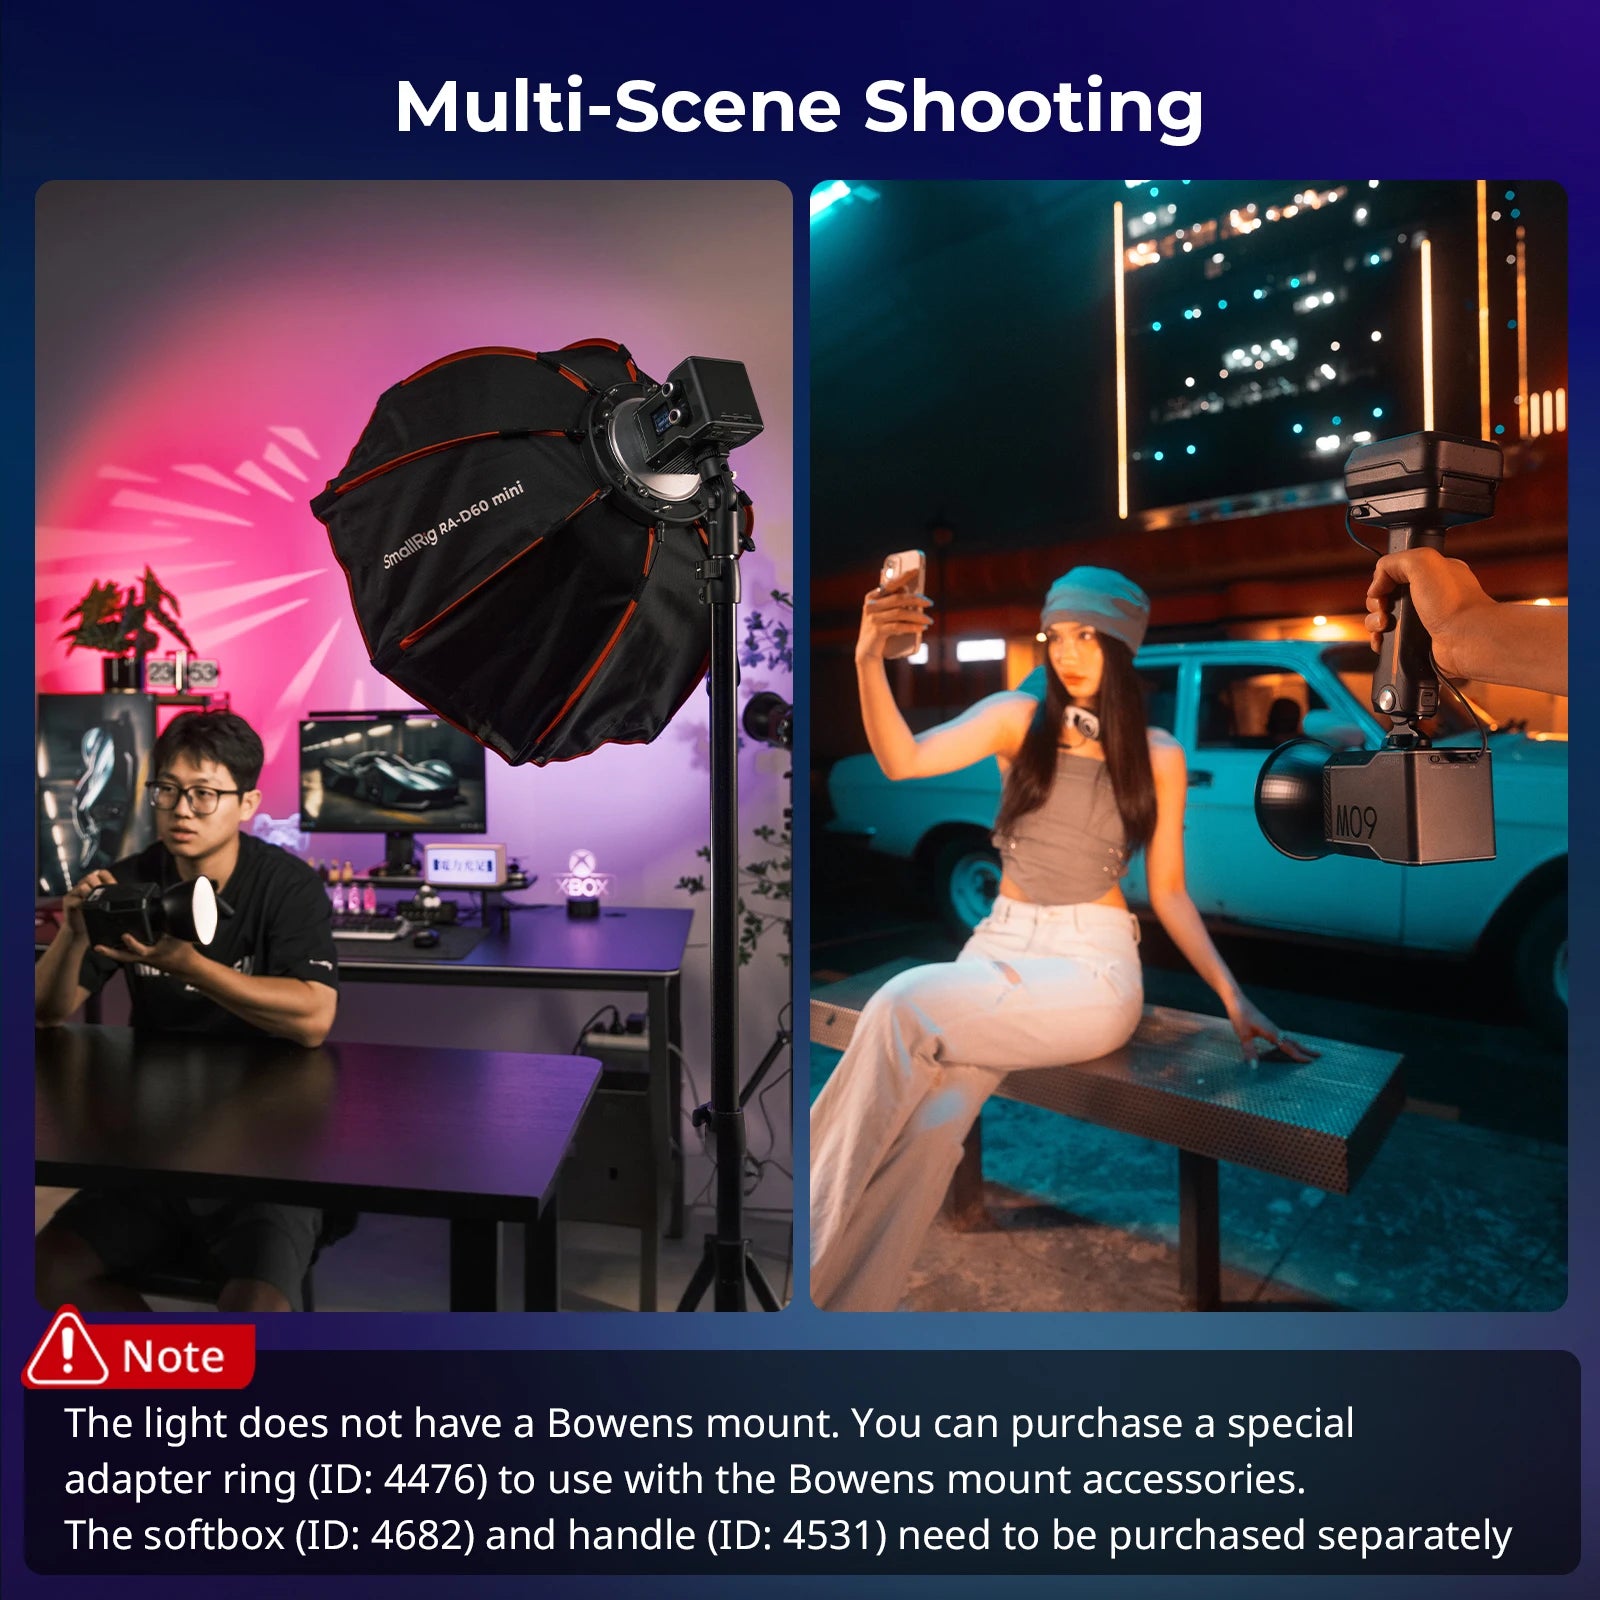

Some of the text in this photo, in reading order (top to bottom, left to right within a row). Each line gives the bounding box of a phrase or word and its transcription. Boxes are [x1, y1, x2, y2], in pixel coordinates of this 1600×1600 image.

[384, 480, 524, 569] SmallRig RA-D60 mini
[556, 878, 609, 897] XBOX
